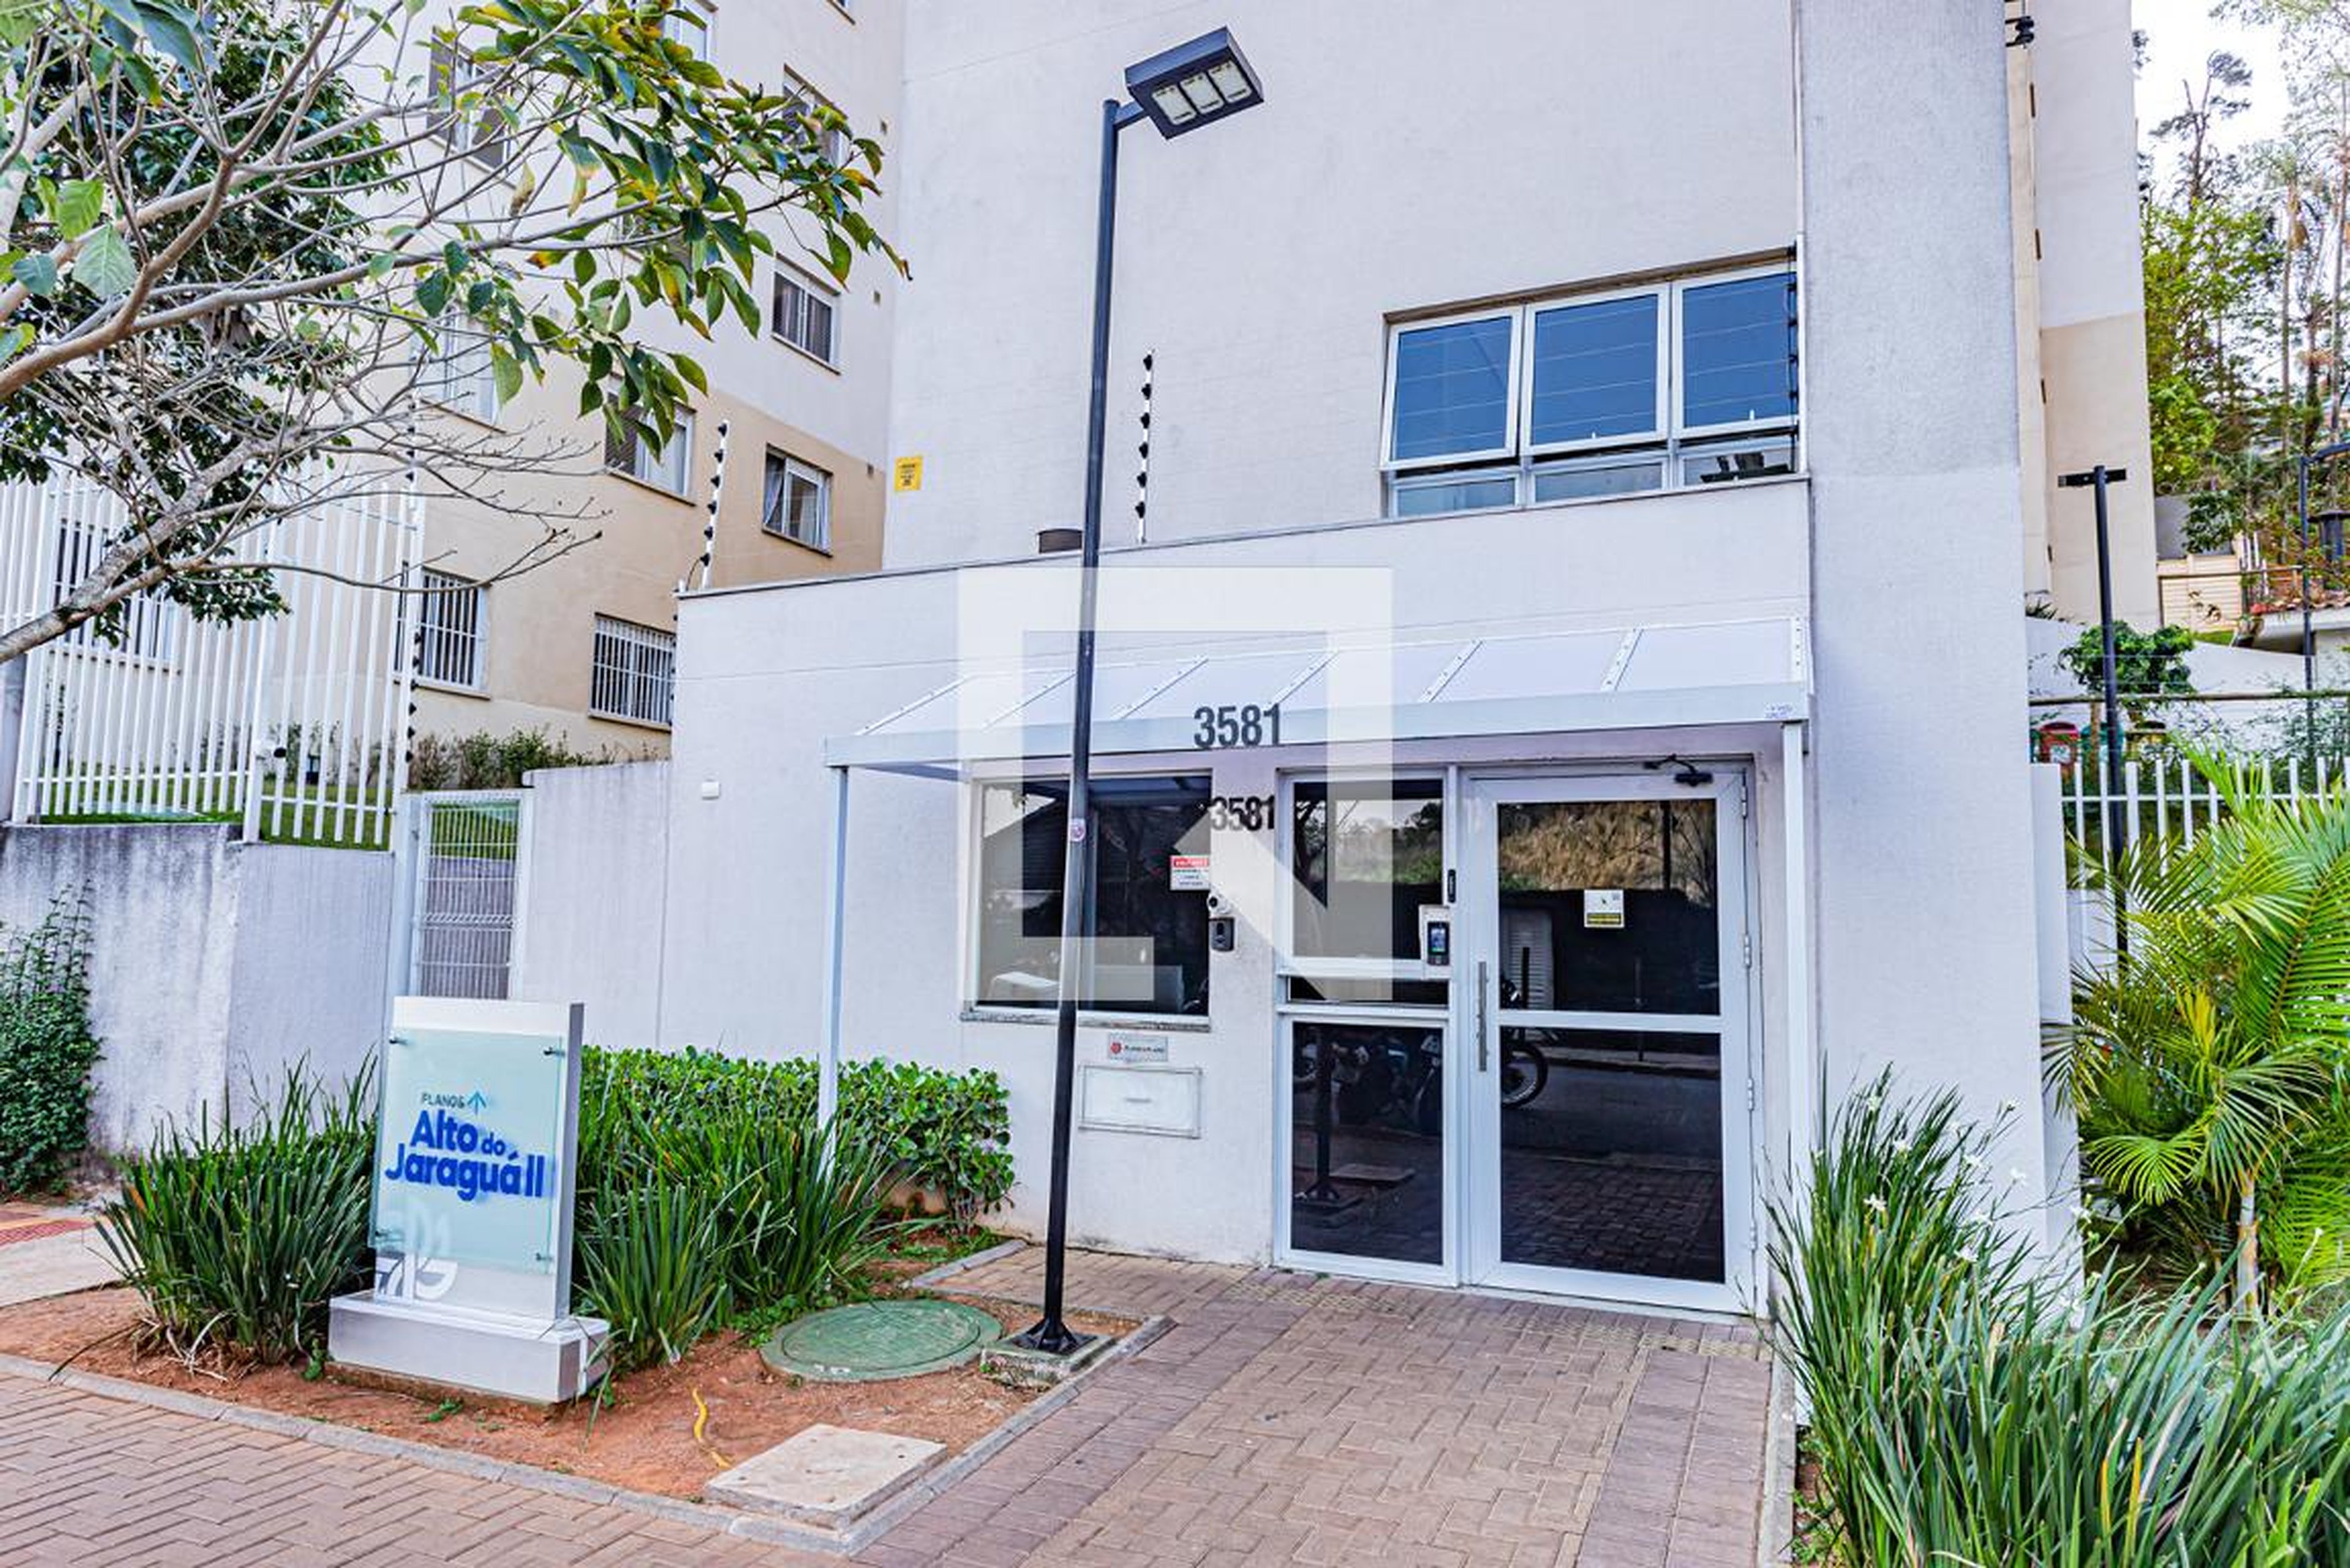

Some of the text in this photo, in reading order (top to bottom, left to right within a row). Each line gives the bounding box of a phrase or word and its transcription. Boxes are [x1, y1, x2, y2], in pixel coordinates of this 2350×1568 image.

[1194, 703, 1280, 749] 3581
[1210, 795, 1275, 831] 3581
[410, 1110, 505, 1156] Alto do
